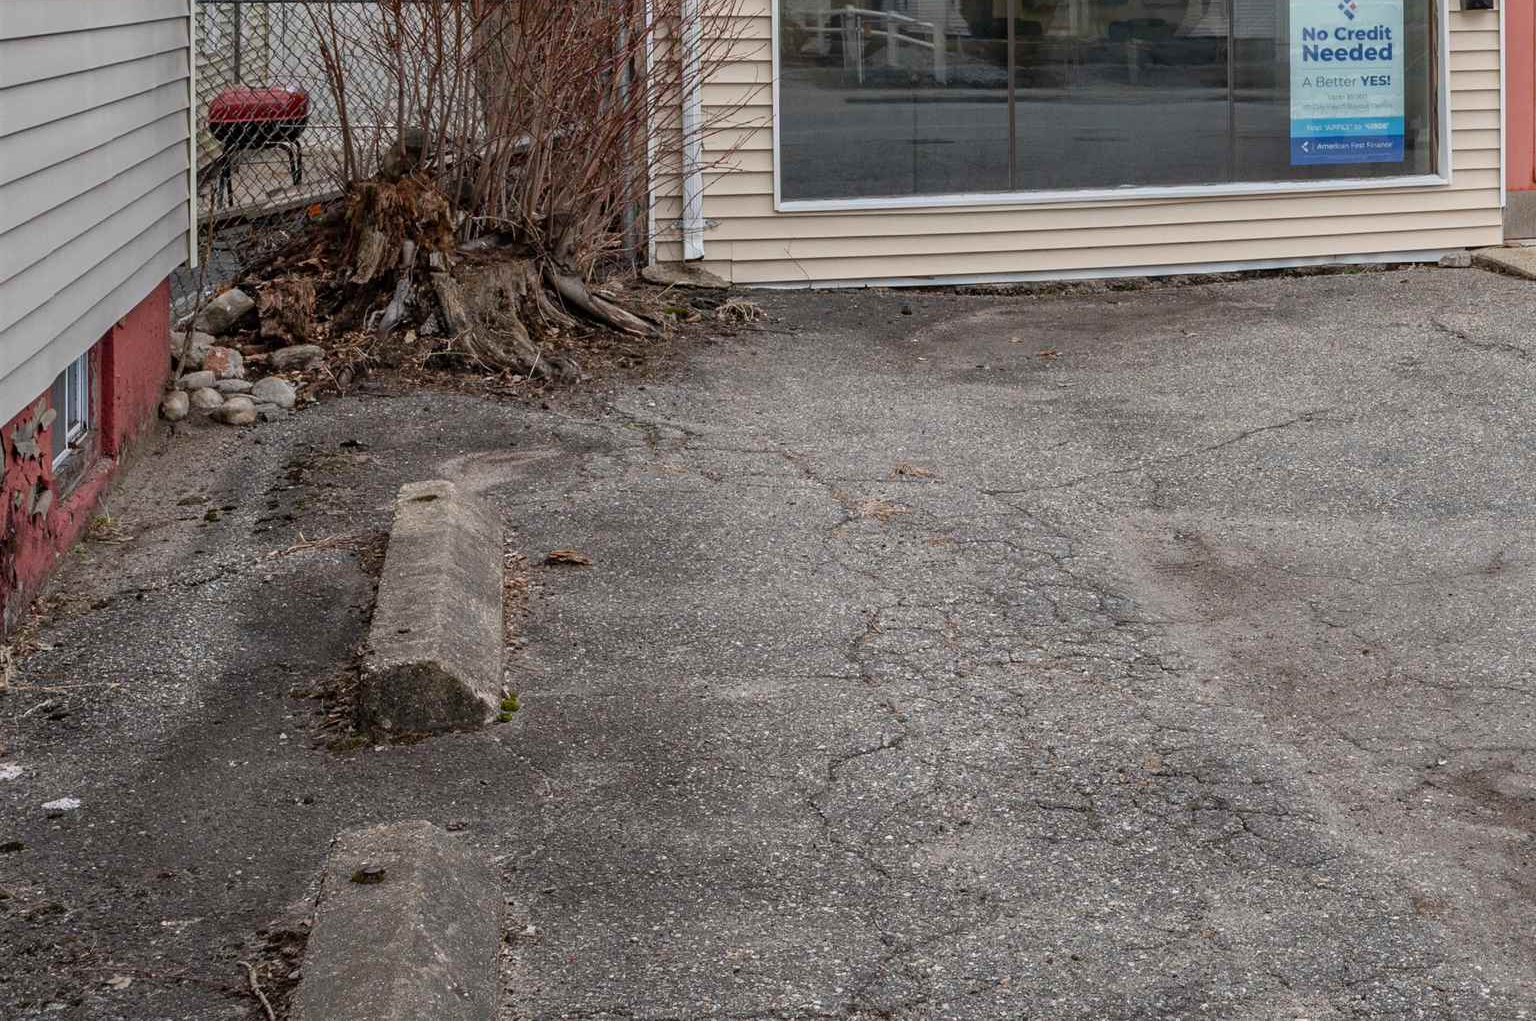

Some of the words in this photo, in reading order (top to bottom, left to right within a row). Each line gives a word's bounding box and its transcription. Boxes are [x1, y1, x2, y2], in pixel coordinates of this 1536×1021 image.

[1302, 27, 1328, 41] No
[1334, 25, 1392, 41] Credit
[1302, 43, 1392, 62] Needed
[1302, 76, 1312, 88] A
[1316, 76, 1356, 88] Better
[1361, 75, 1391, 86] YES!
